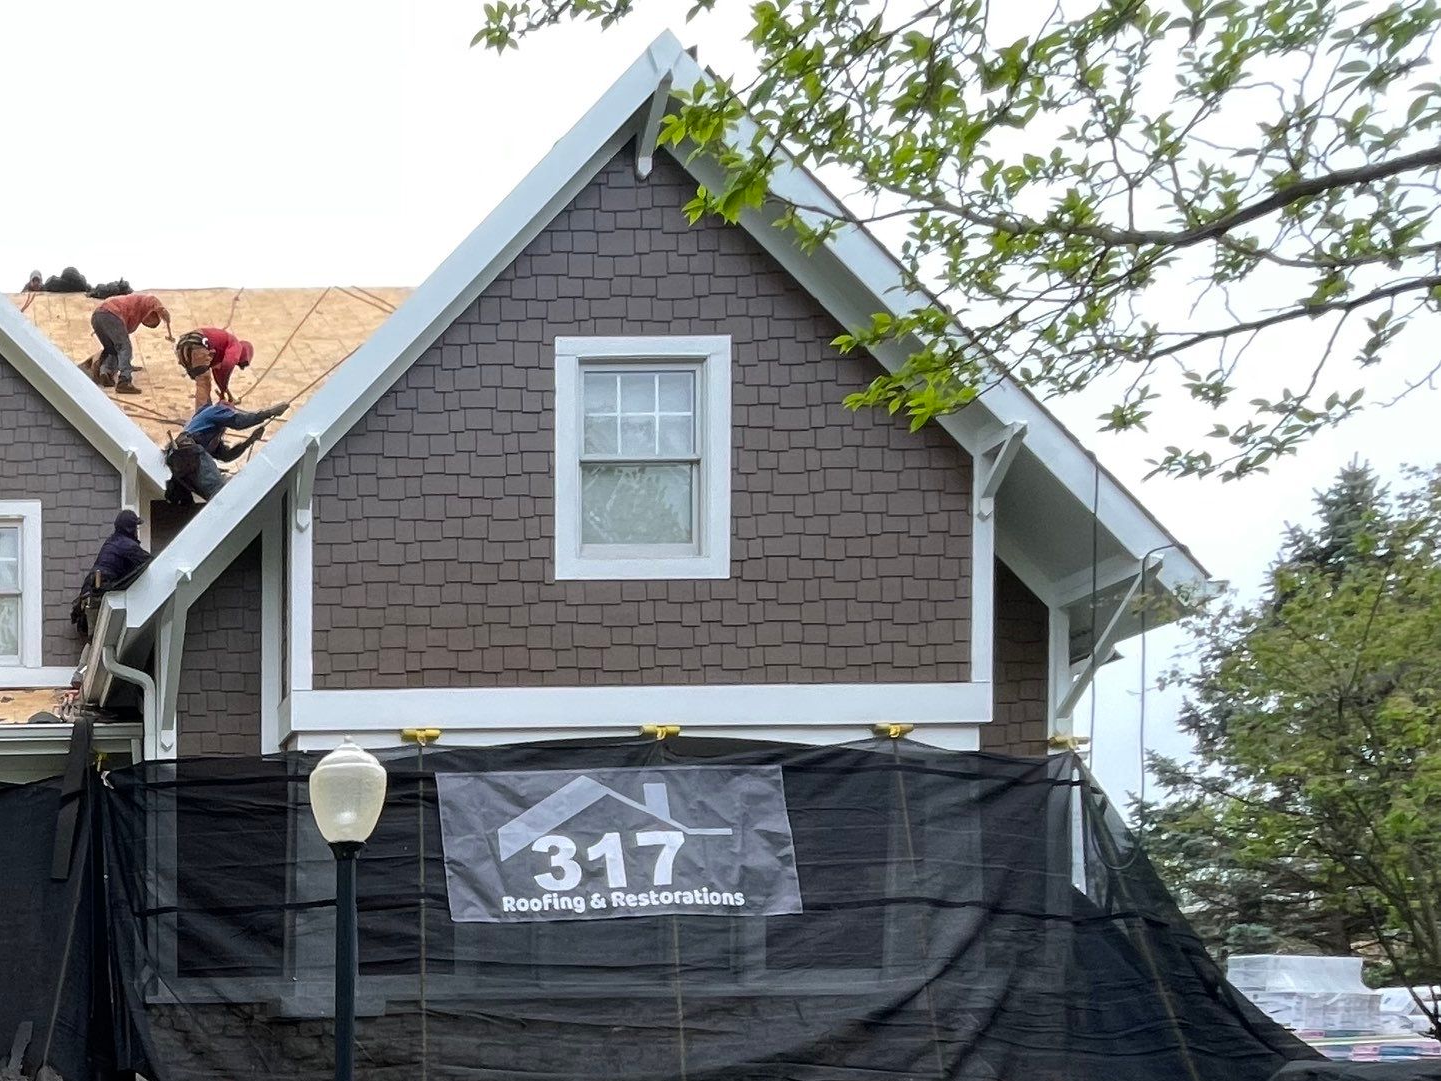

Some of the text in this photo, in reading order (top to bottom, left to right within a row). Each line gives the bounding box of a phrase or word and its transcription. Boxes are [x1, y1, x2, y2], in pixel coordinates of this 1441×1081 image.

[531, 831, 685, 891] 317
[502, 887, 745, 913] Roofing & Restorations
